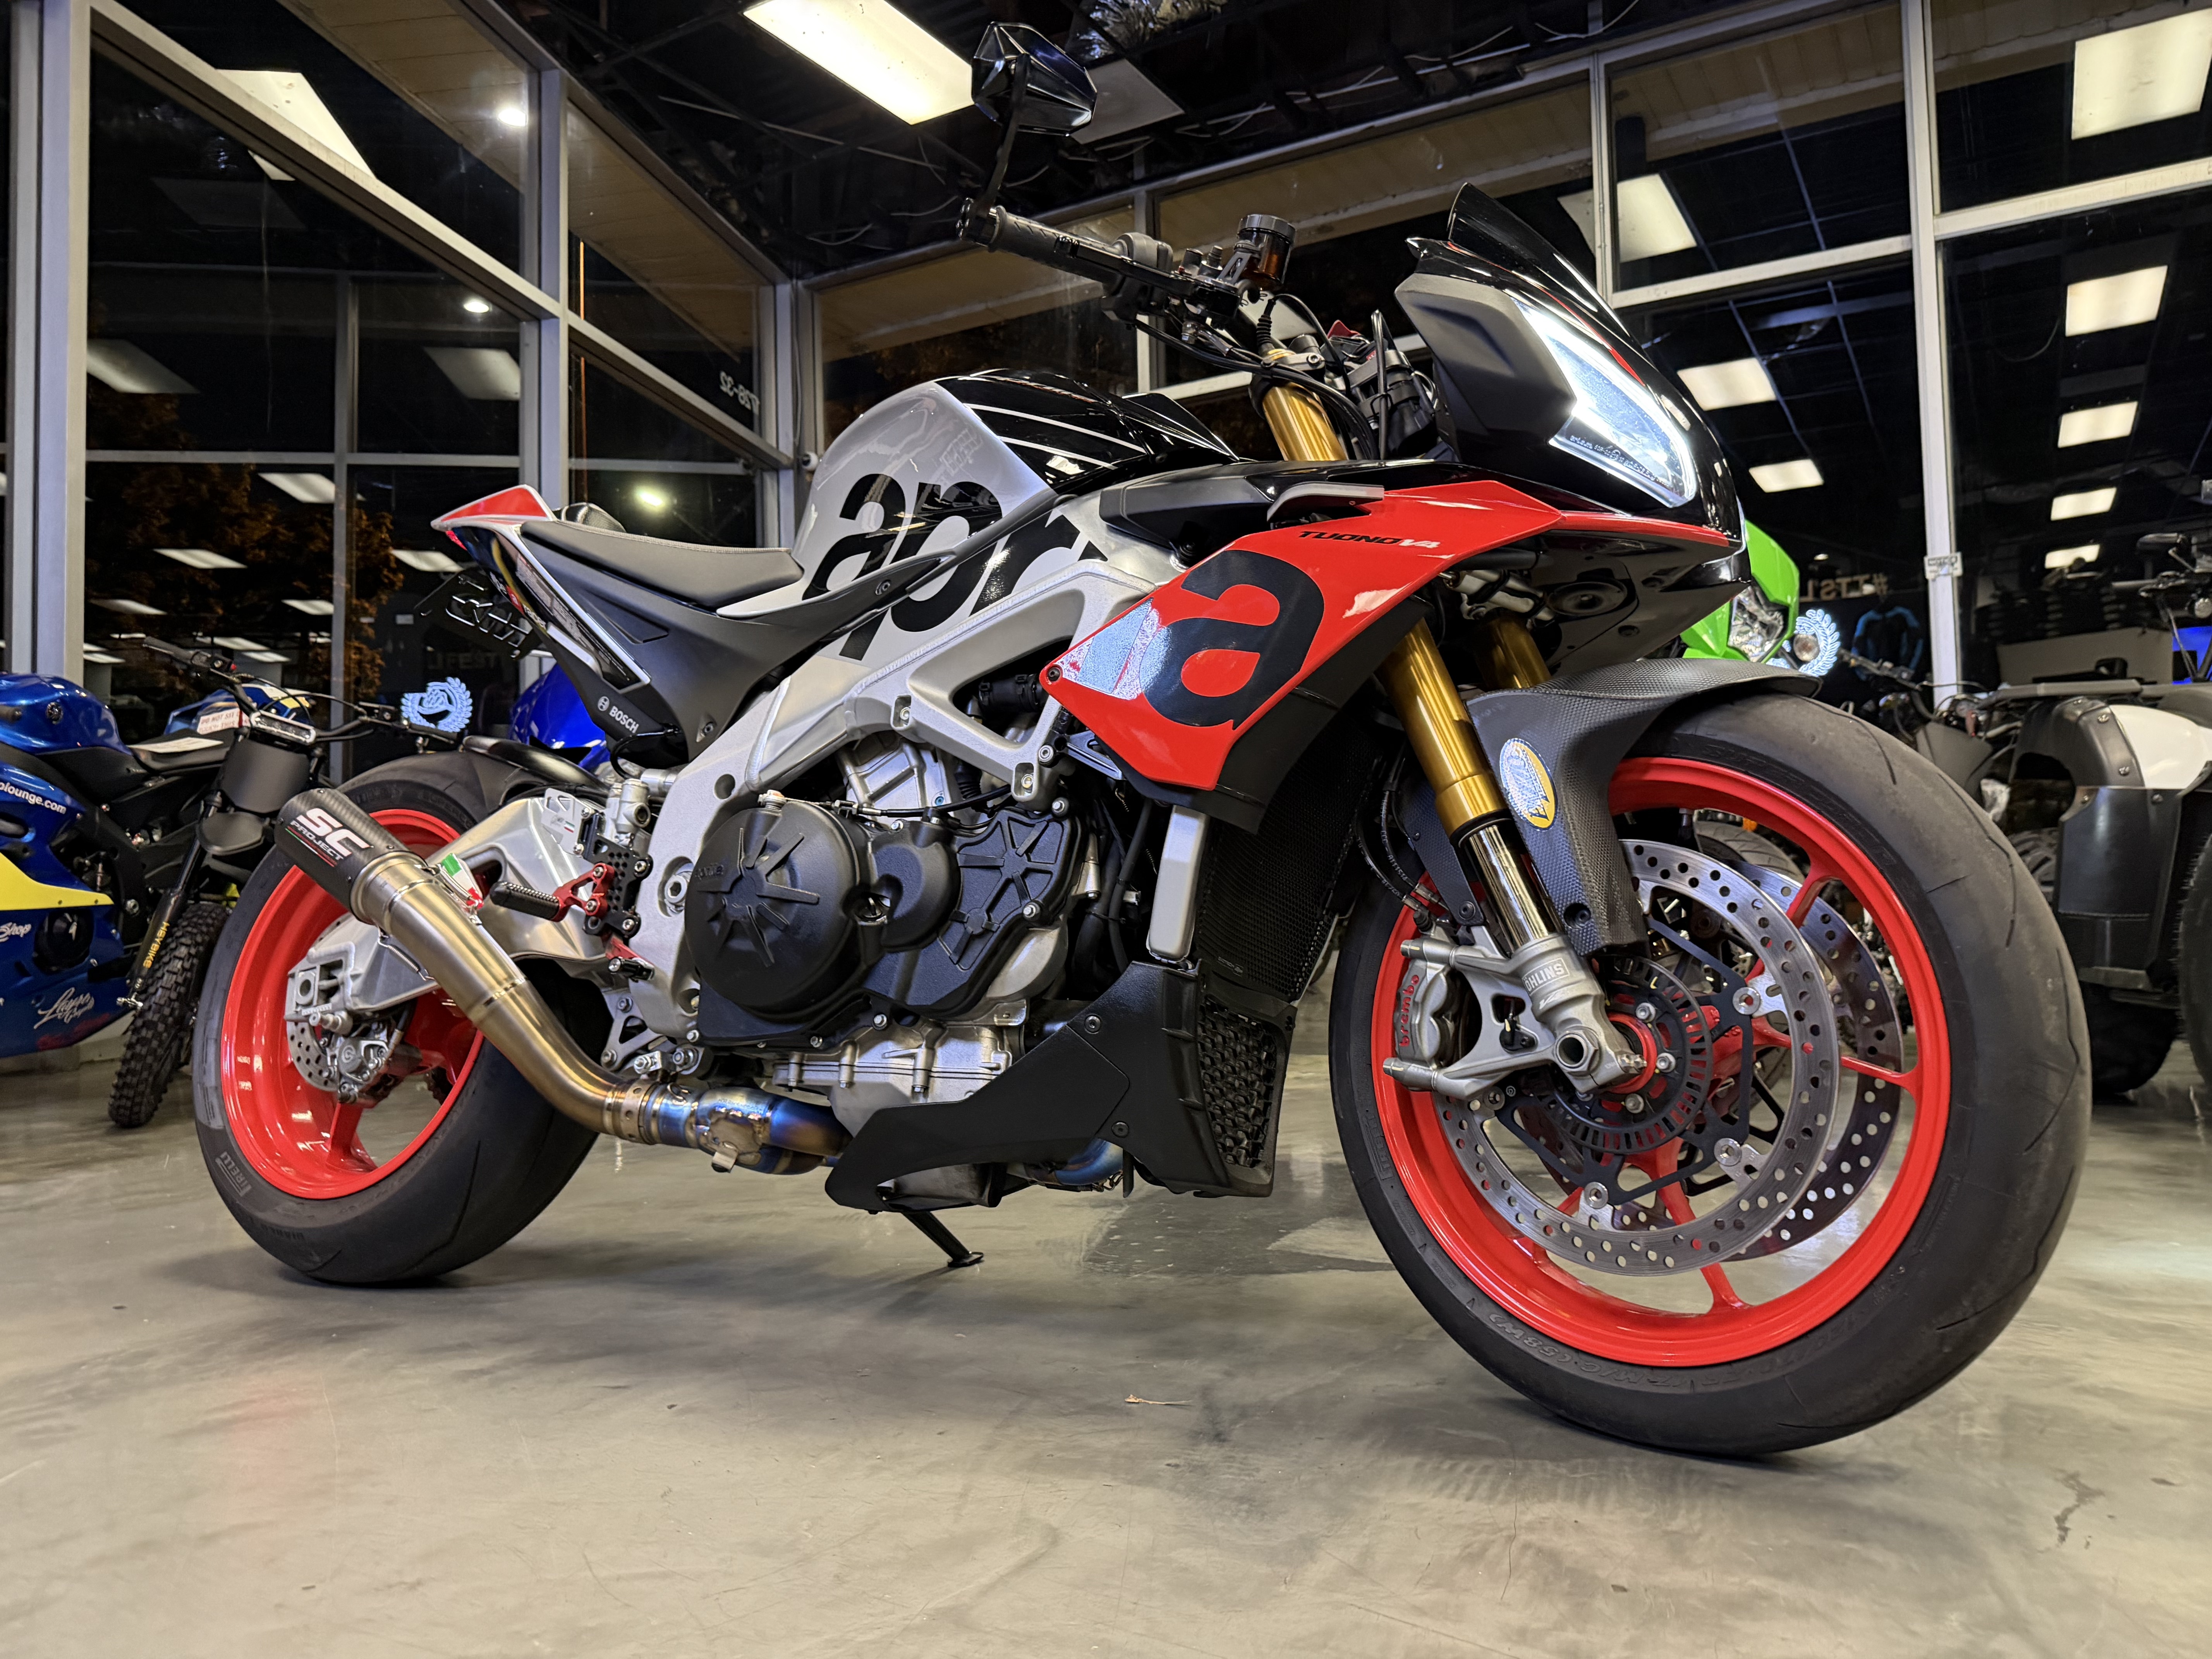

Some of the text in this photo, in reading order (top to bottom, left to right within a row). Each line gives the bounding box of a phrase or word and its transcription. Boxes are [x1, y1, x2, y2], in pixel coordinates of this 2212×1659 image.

[1298, 531, 1404, 544] TUONO
[609, 706, 639, 733] BOSCH
[290, 820, 344, 861] PROJECT
[295, 807, 371, 857] SC
[143, 922, 170, 969] HEYBIKE
[1524, 963, 1565, 992] ÖHLINS
[1399, 974, 1420, 1047] brembo
[215, 1151, 252, 1197] PIRELLI
[1489, 1314, 1572, 1362] (58W)
